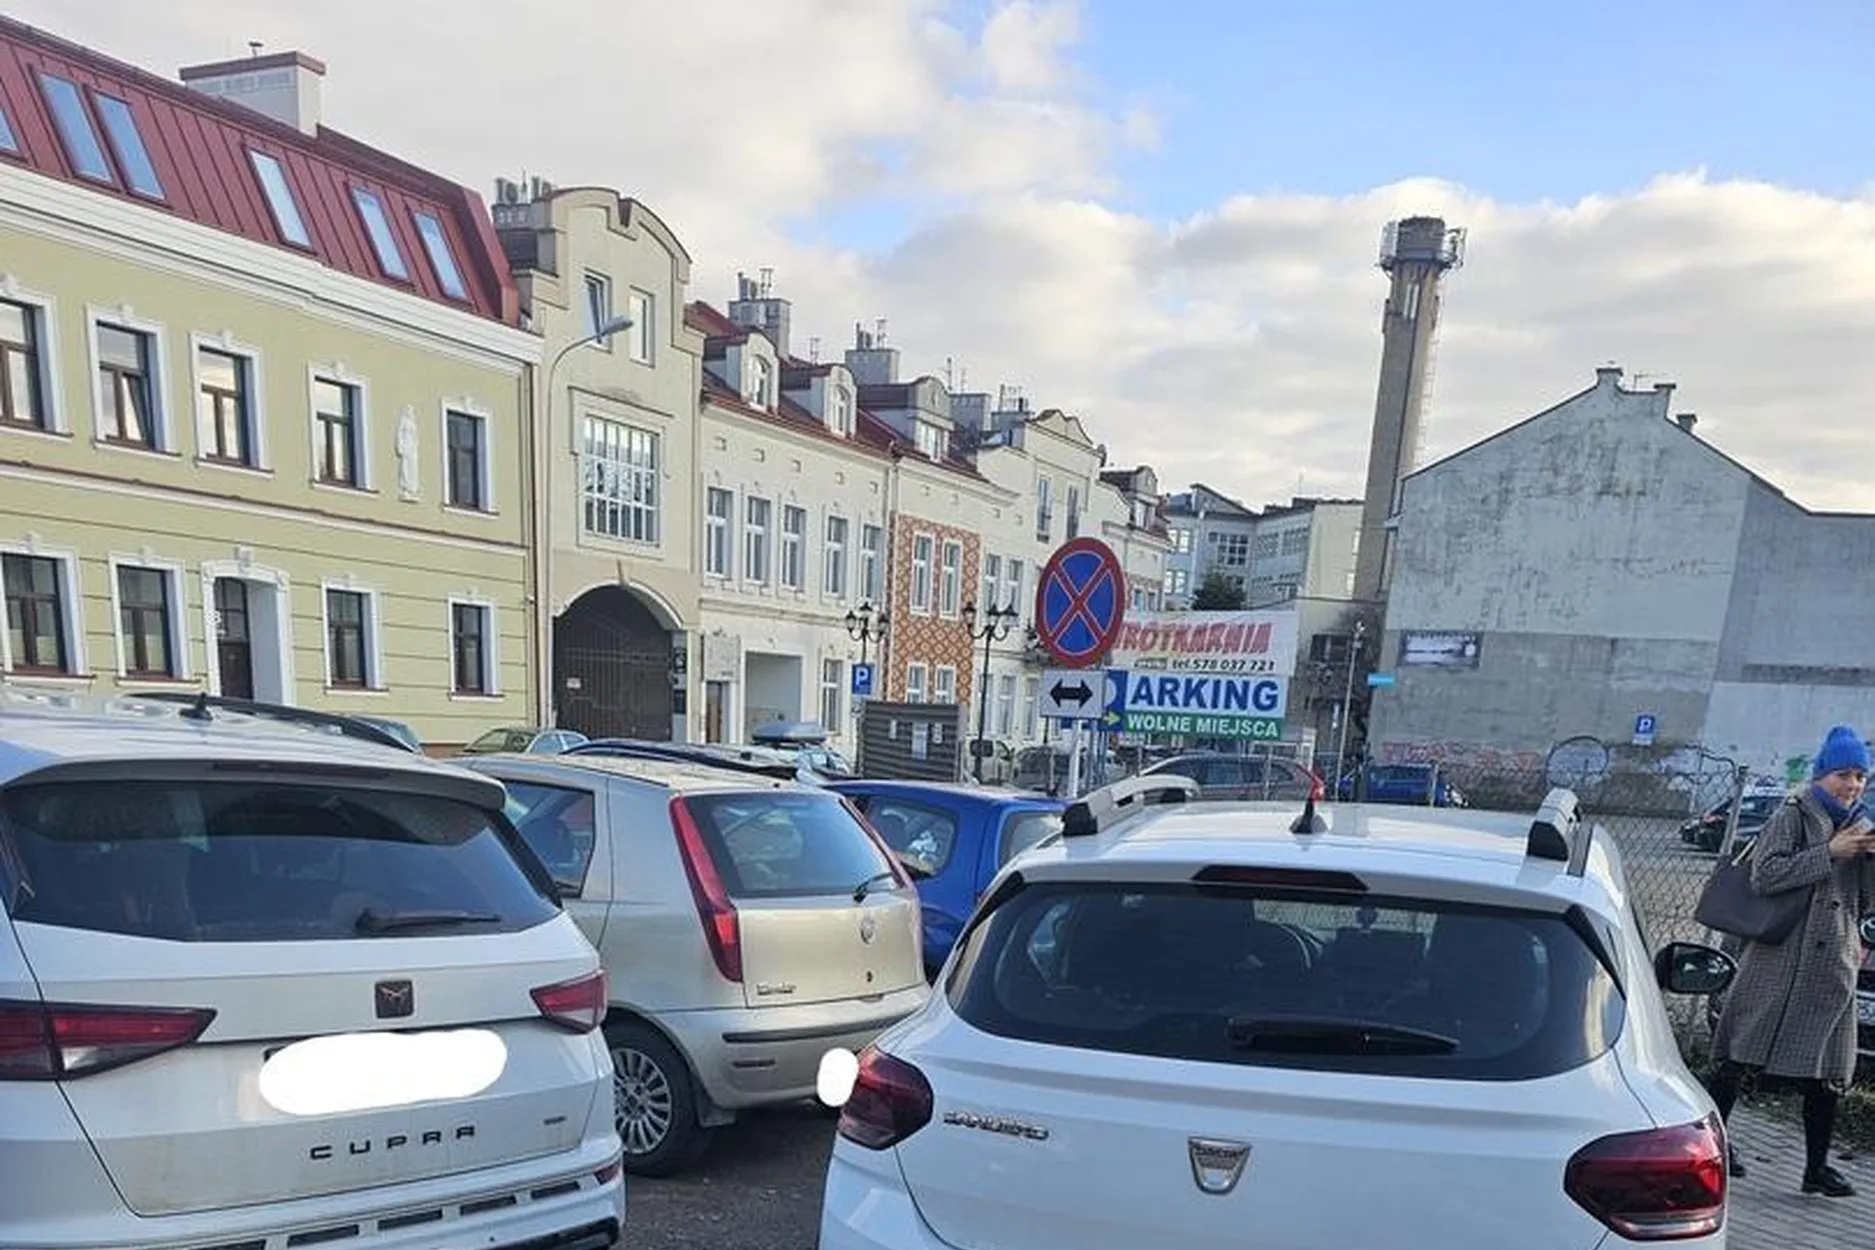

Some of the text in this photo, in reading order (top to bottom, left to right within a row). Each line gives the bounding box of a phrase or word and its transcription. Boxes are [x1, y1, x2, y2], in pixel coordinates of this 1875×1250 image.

[1113, 621, 1273, 653] ROTKARNIA
[1250, 660, 1275, 671] 721
[1127, 712, 1278, 737] WOLNE MIEJSCA
[310, 1125, 475, 1160] CUPRA
